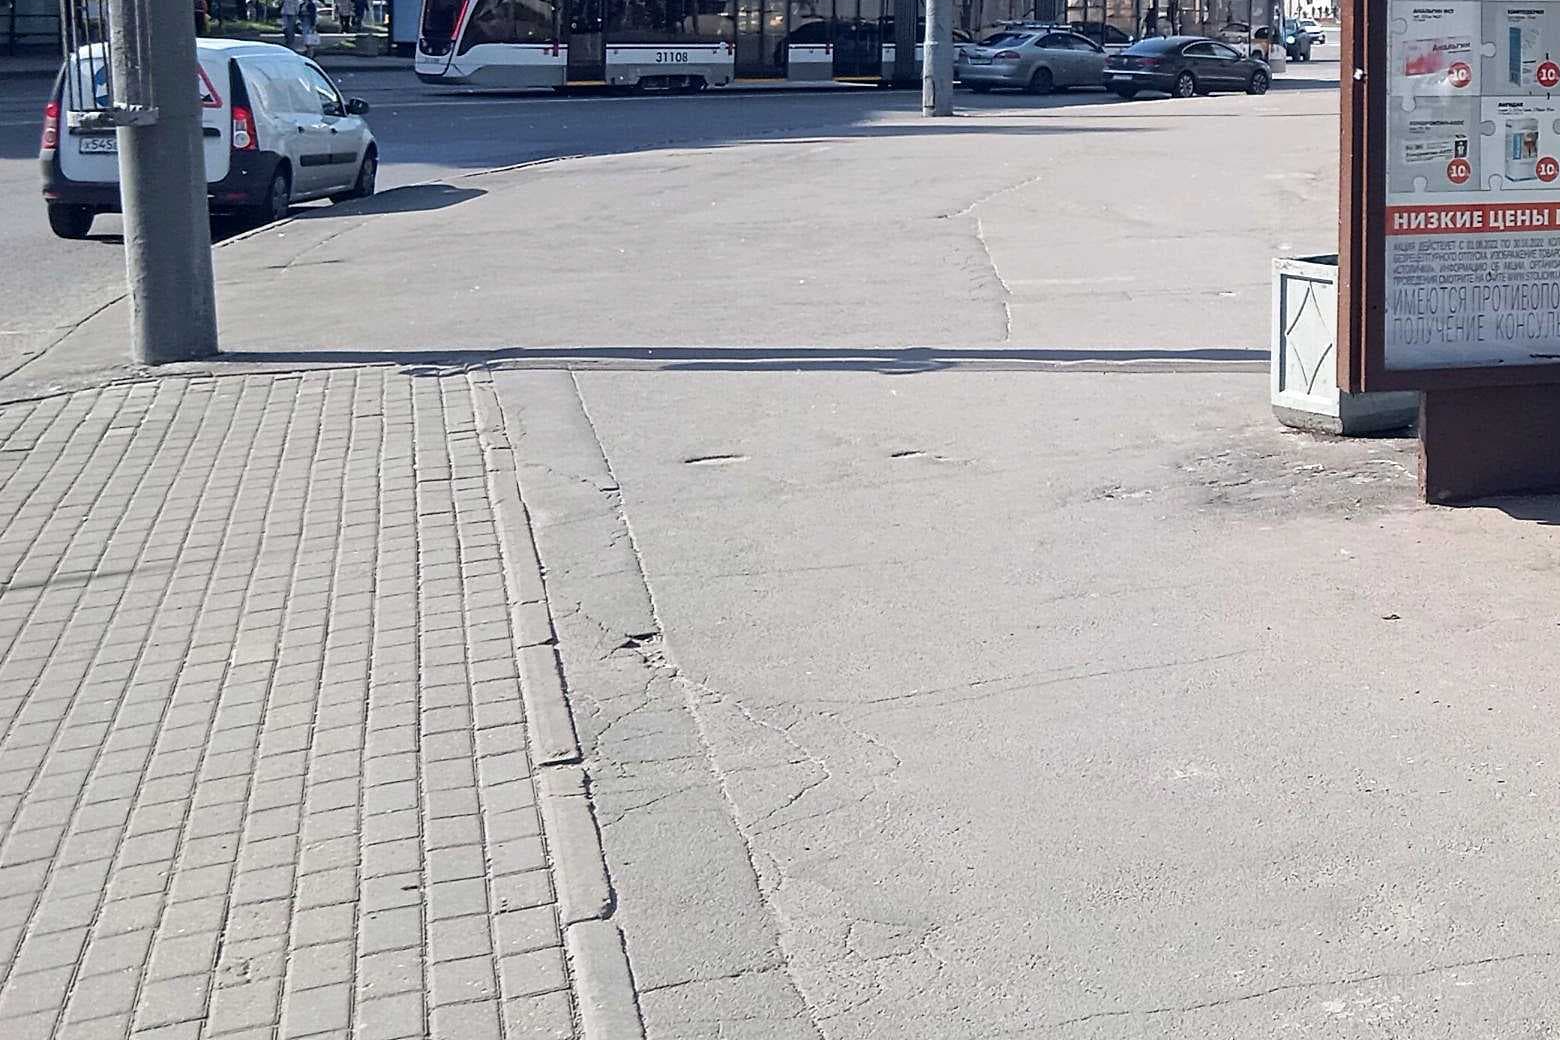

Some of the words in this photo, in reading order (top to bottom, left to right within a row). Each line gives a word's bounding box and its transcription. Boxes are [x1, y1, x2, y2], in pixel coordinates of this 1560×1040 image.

[656, 52, 688, 62] 31108
[1393, 210, 1483, 230] НИЗКИЕ
[1489, 208, 1549, 230] ЦЕНЫ
[1393, 286, 1467, 315] ИМЕЮТСЯ
[1393, 314, 1485, 345] ПОЛУЧЕНИЕ
